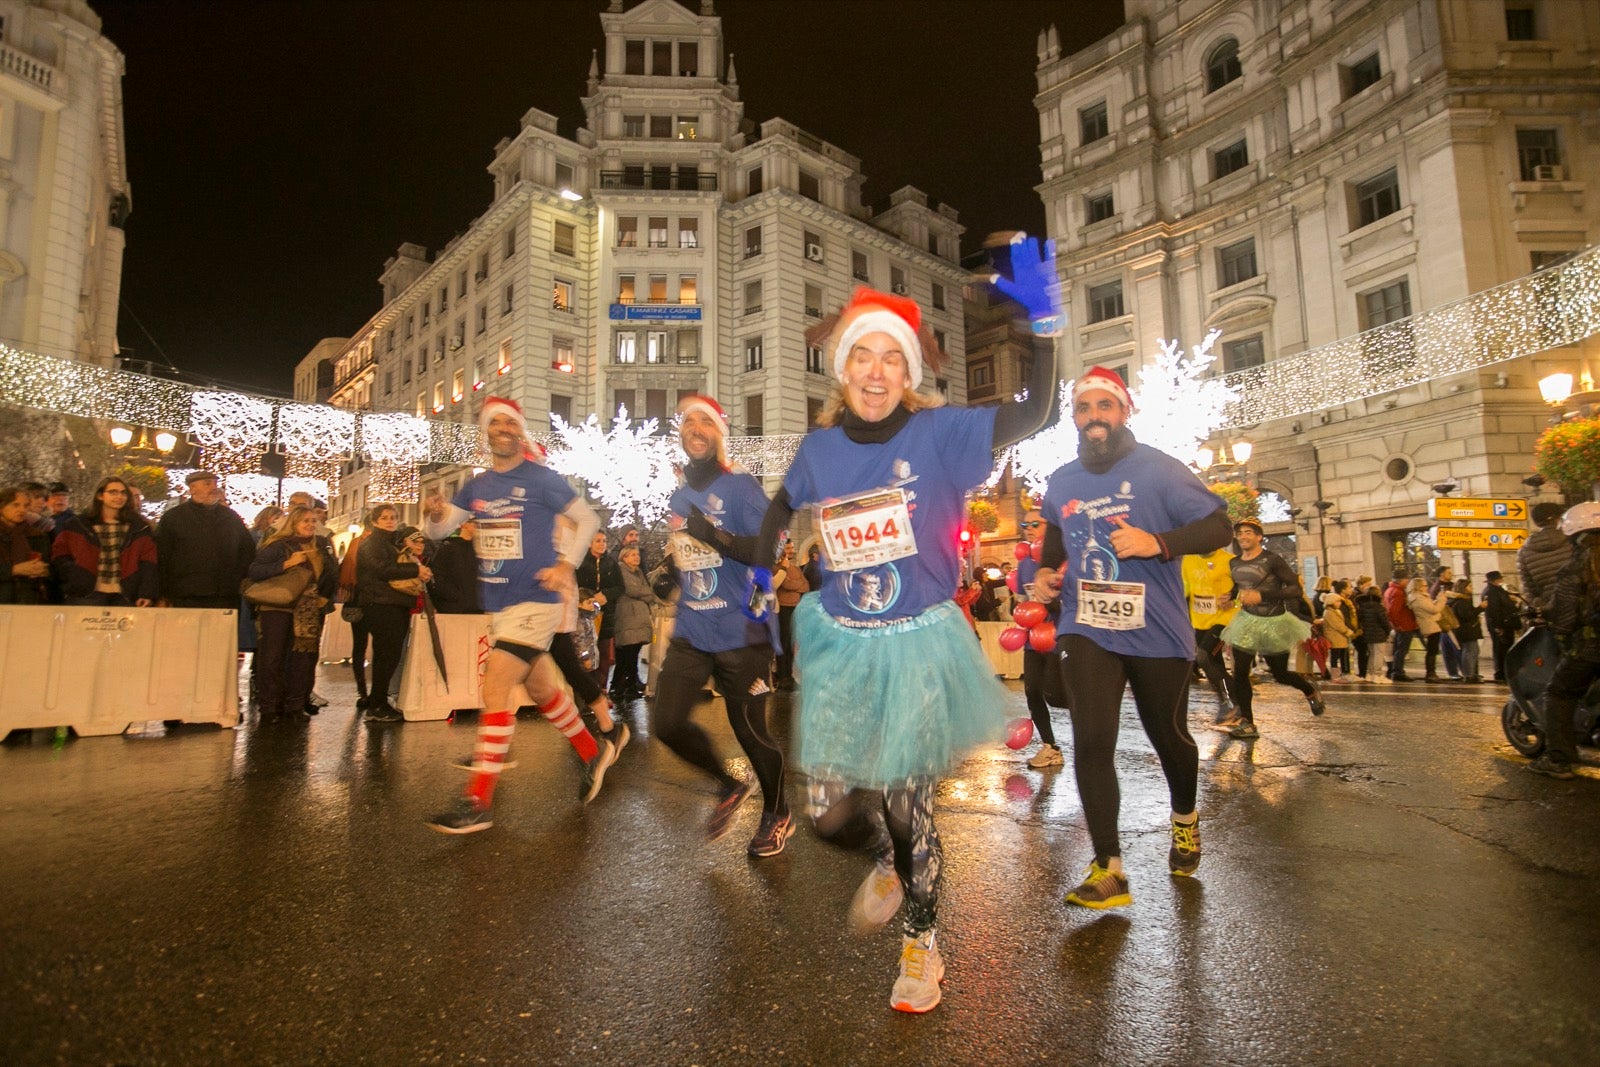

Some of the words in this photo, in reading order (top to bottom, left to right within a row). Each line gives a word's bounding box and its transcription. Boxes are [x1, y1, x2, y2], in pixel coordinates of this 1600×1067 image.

[835, 518, 900, 550] 1944
[1439, 530, 1469, 538] Oficina
[1088, 598, 1134, 617] 1249
